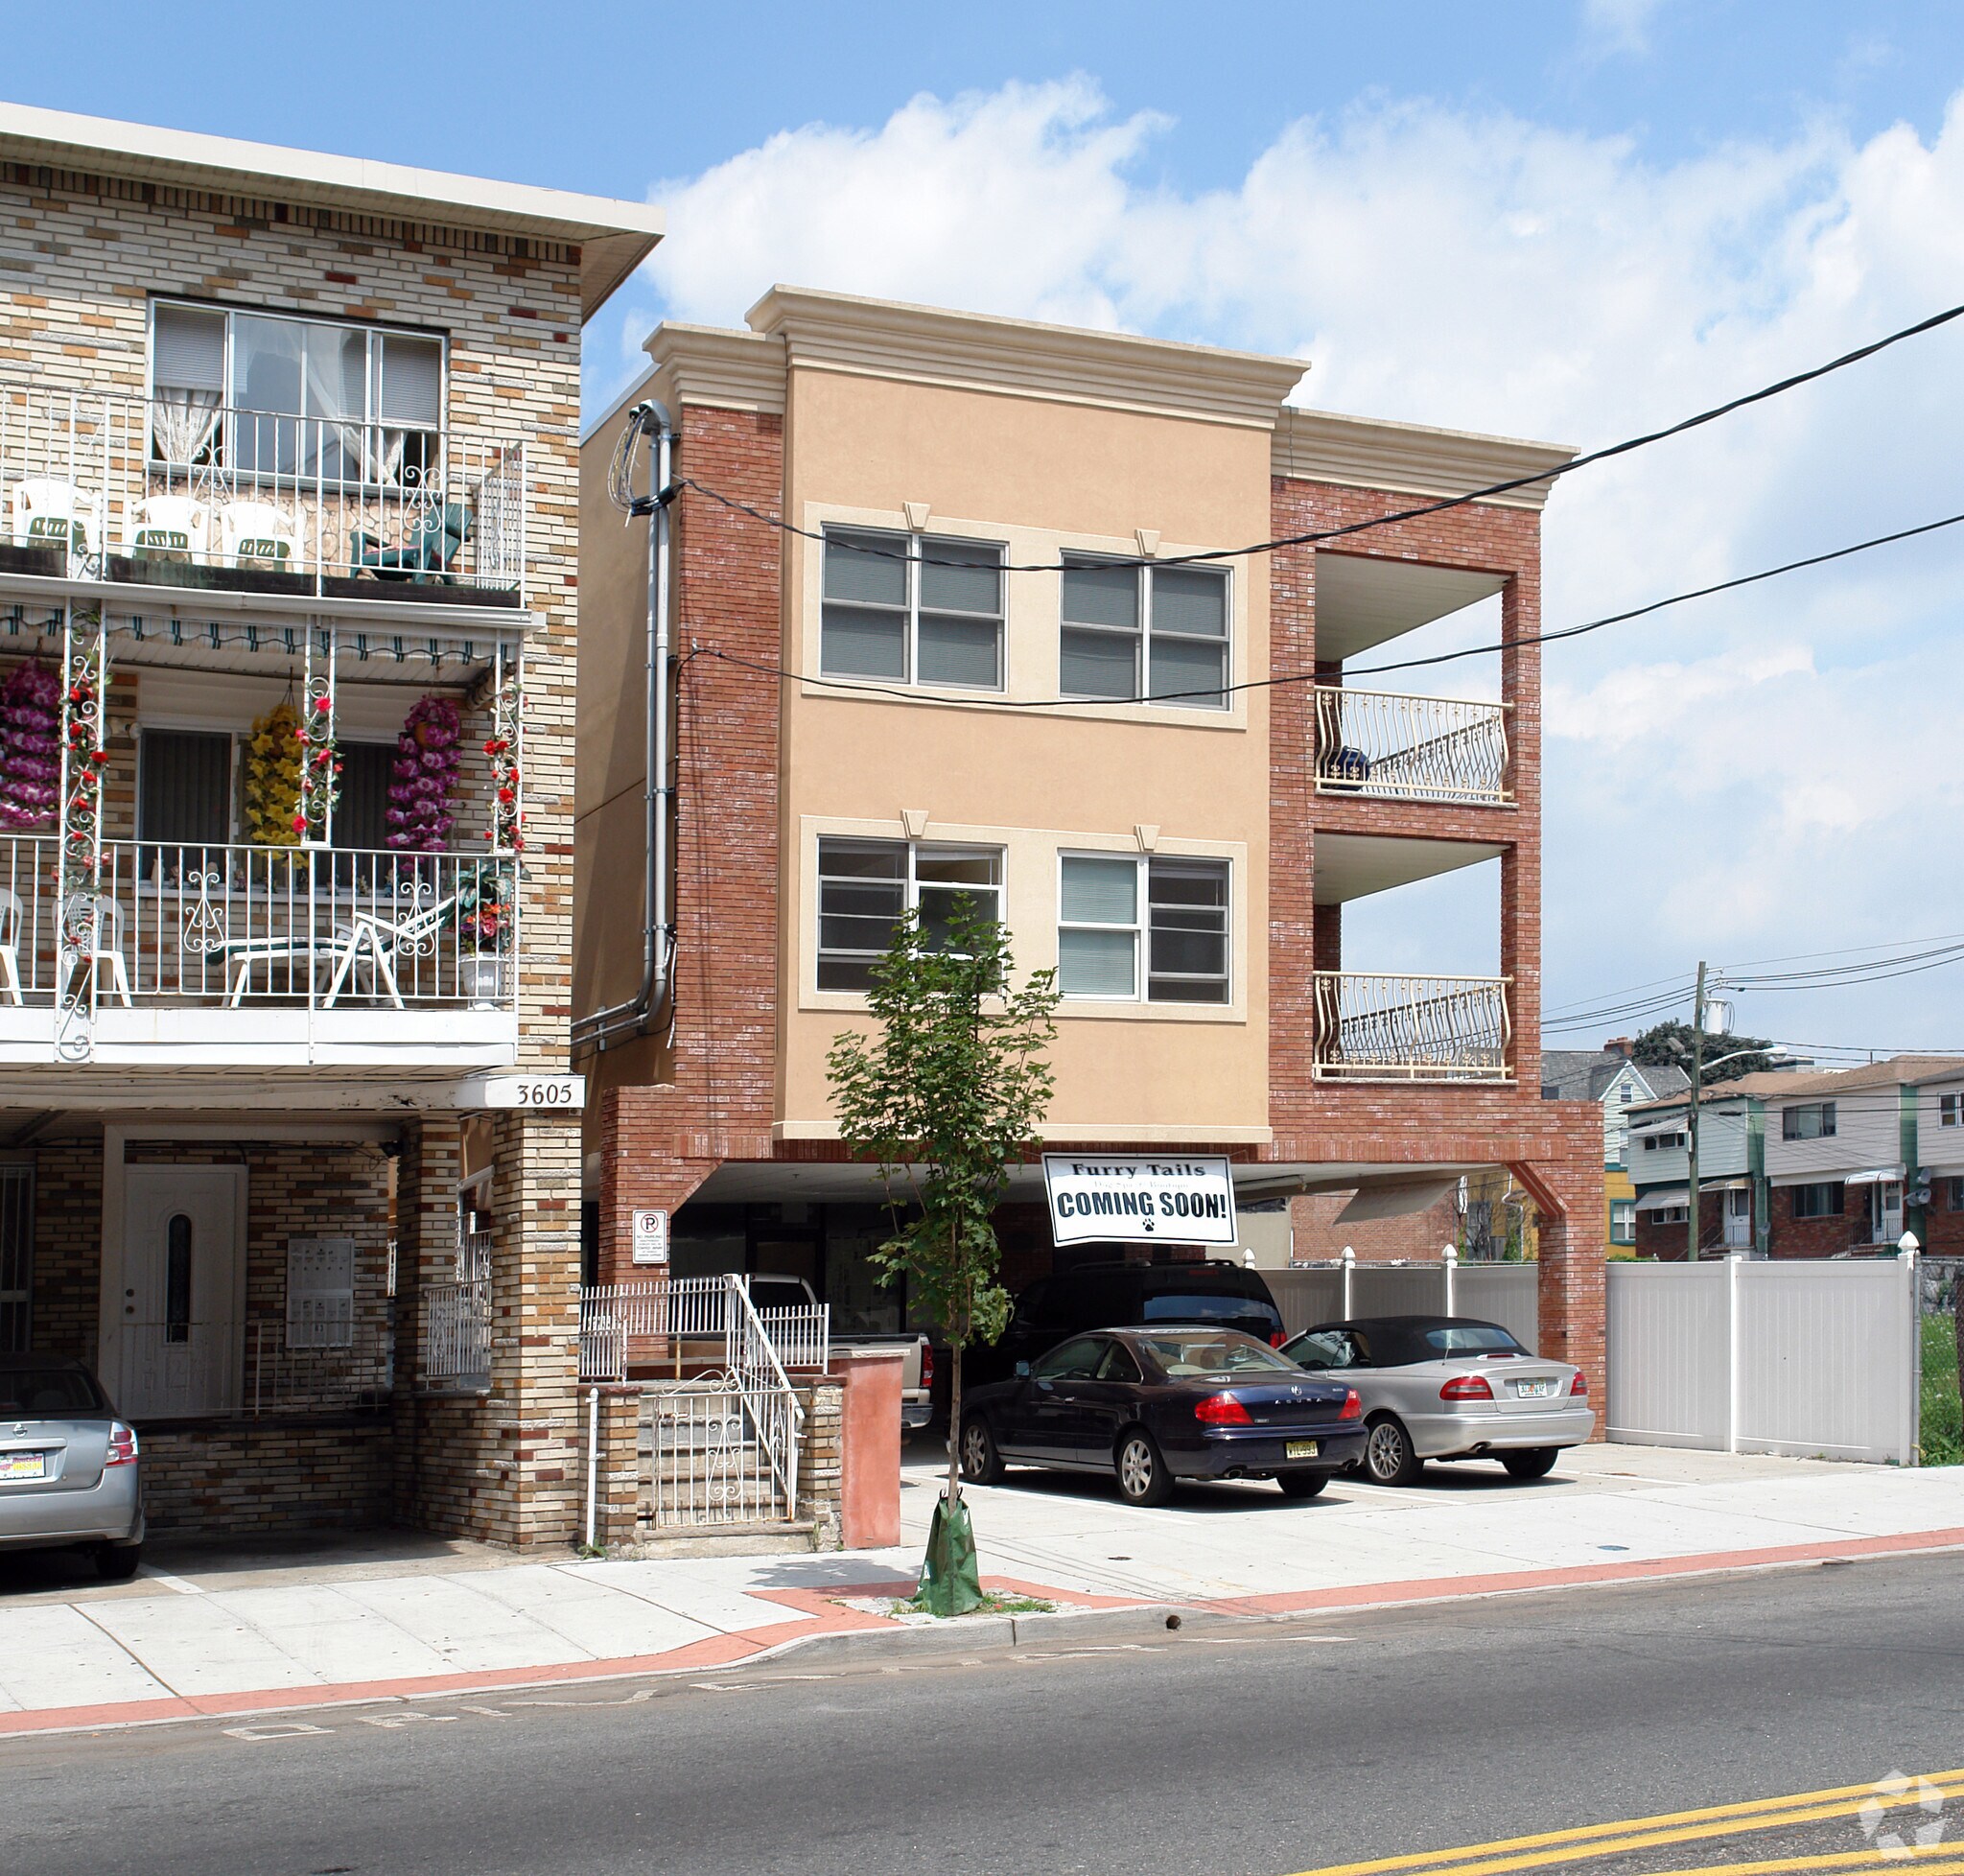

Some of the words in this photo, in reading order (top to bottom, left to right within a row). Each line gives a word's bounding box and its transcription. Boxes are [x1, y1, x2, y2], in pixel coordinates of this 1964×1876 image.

[517, 1084, 573, 1105] 3605
[1070, 1162, 1138, 1180] Furry
[1146, 1163, 1206, 1176] Tails
[1057, 1192, 1155, 1218] COMING
[1159, 1192, 1228, 1218] SOON!
